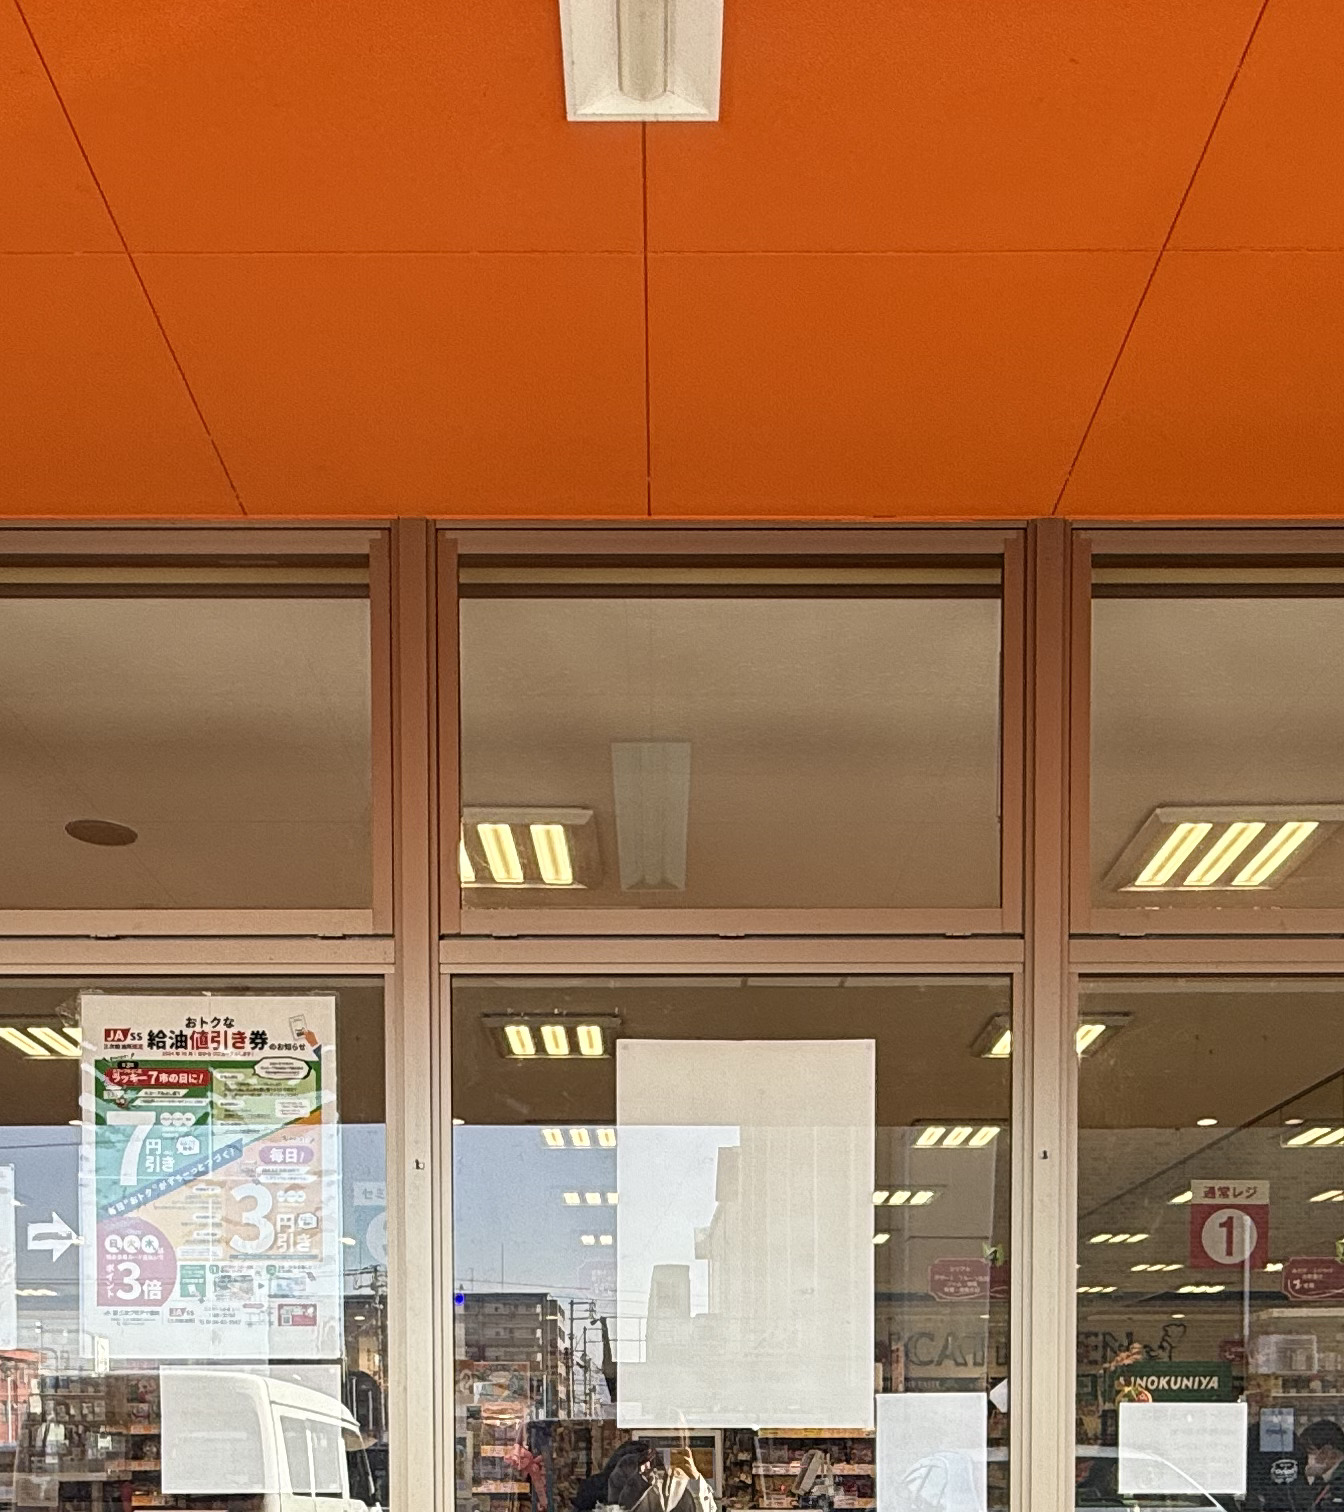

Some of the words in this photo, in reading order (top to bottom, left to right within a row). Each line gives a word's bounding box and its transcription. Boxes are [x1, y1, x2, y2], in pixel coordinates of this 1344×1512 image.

[186, 1016, 235, 1028] おトクな
[107, 1030, 124, 1042] JA
[130, 1032, 143, 1041] SS
[107, 1111, 156, 1187] 7
[145, 1139, 162, 1155] 円
[145, 1155, 175, 1173] 引き
[1202, 1185, 1258, 1199] 通常レジ
[229, 1183, 275, 1254] 3
[277, 1214, 295, 1233] 円
[277, 1233, 312, 1252] 引き
[1218, 1215, 1235, 1257] 1
[105, 1263, 115, 1299] ポイント
[117, 1261, 142, 1301] 3
[143, 1280, 163, 1300] 倍
